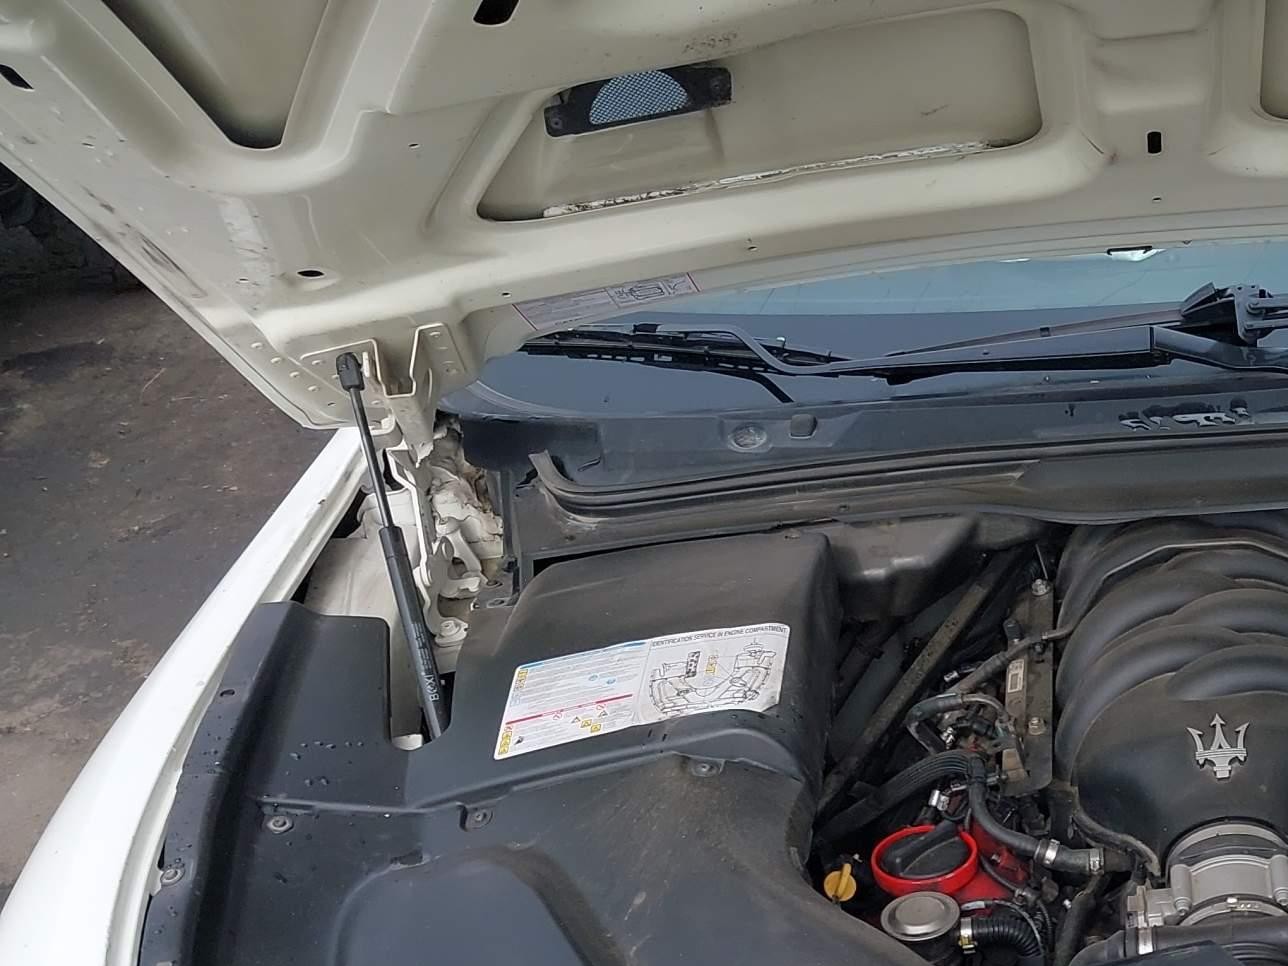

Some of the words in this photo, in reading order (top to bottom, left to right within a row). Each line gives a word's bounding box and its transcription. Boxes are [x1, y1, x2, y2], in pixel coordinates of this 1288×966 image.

[693, 631, 717, 641] SERVICE
[724, 629, 745, 637] ENGINE
[745, 625, 788, 635] COMPARTMENT
